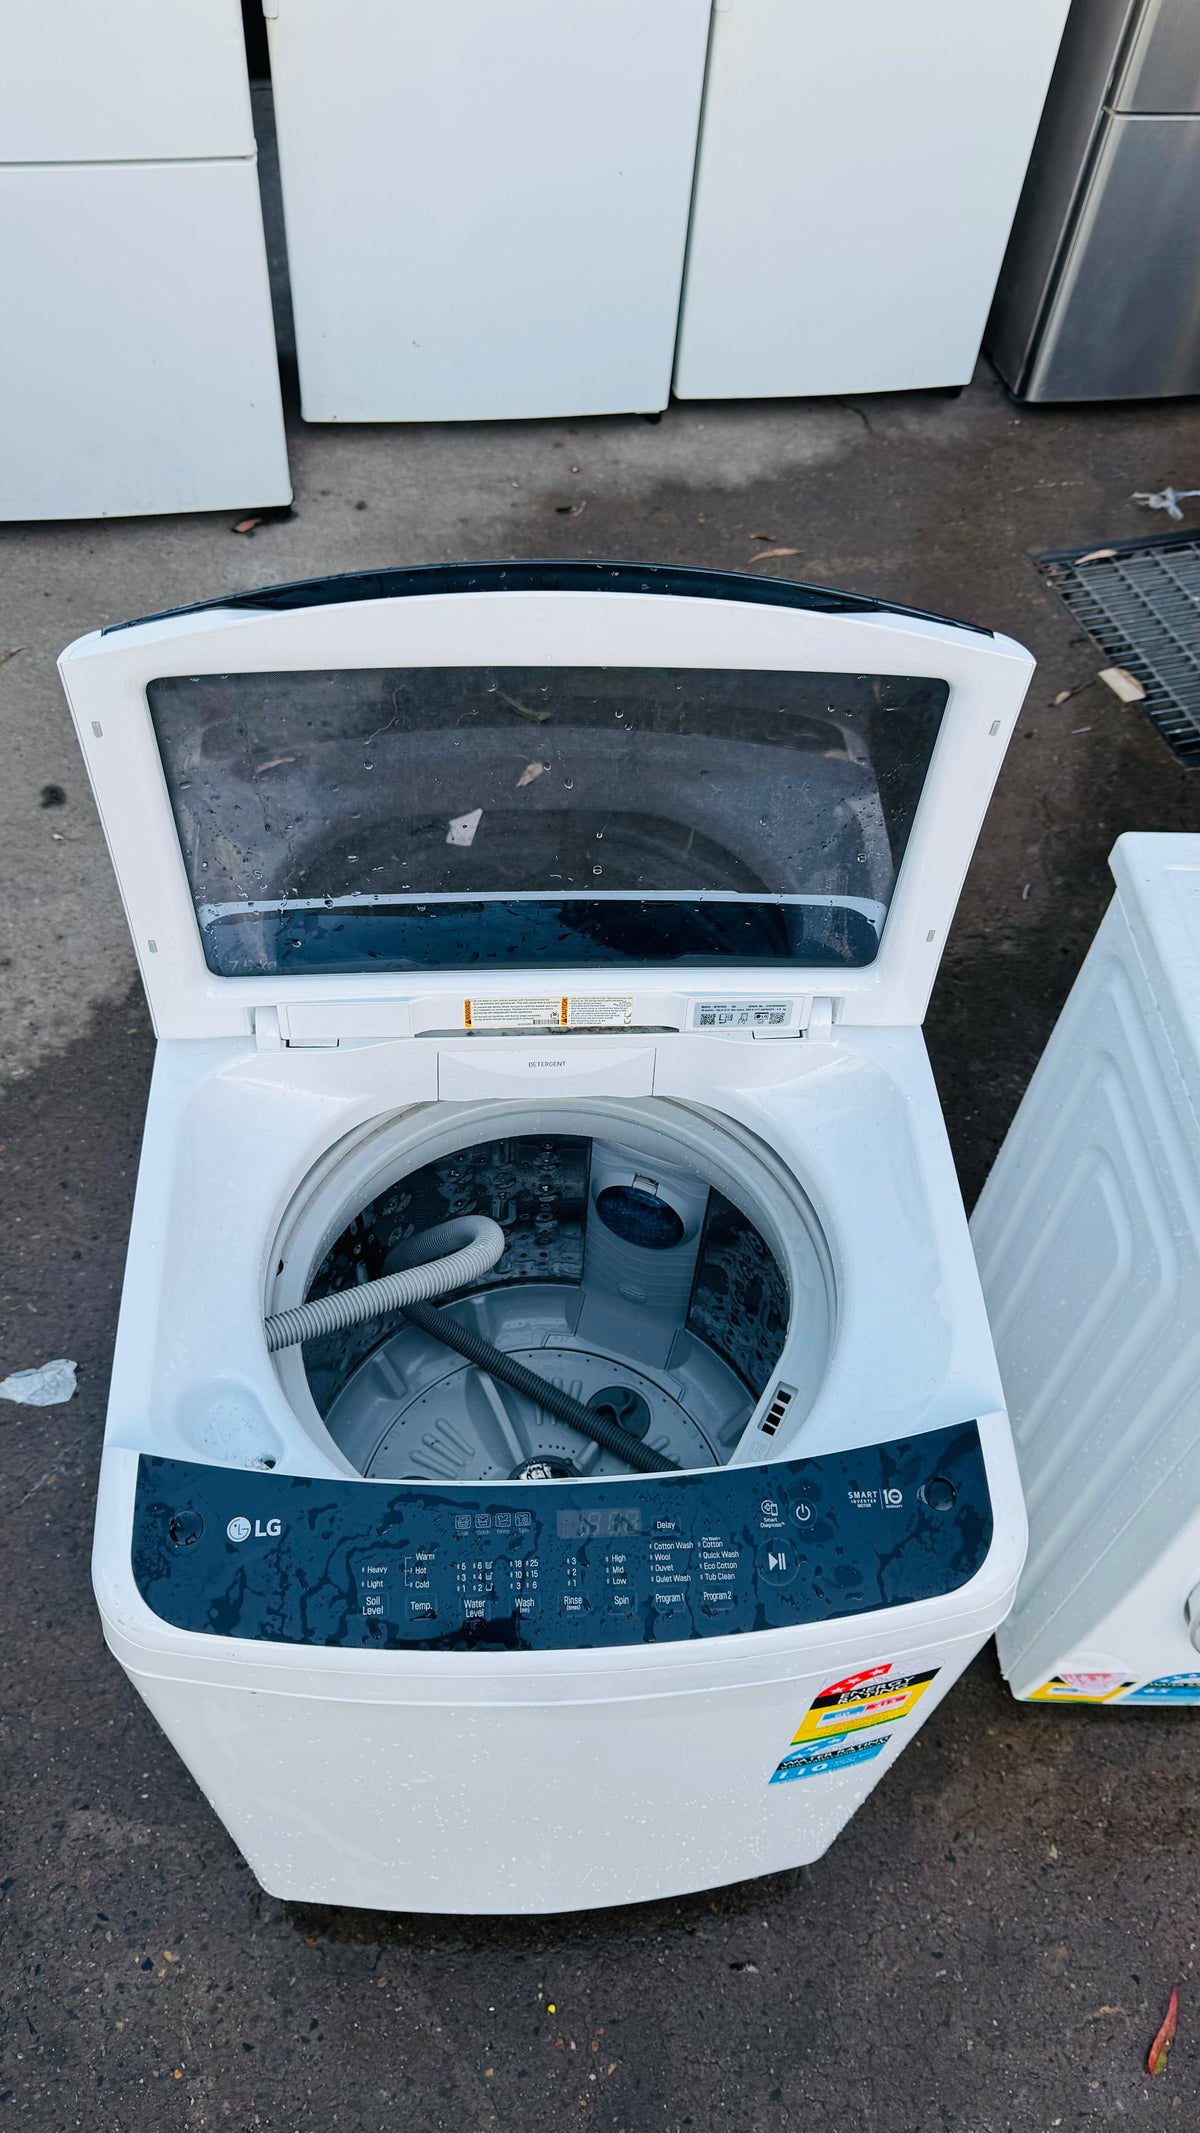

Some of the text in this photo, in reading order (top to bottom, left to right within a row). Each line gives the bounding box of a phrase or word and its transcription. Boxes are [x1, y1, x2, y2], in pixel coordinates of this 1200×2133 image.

[848, 1491, 877, 1499] SMART
[883, 1488, 903, 1504] 10
[254, 1518, 282, 1538] LG
[656, 1521, 676, 1530] Delay
[675, 1541, 694, 1549] Wash
[702, 1540, 723, 1548] Cotton
[415, 1552, 435, 1560] Warm
[611, 1554, 626, 1563] High
[654, 1553, 671, 1561] Wool
[721, 1550, 739, 1558] Wash
[514, 1559, 539, 1568] 18 25
[655, 1564, 674, 1572] Duvet
[367, 1566, 388, 1574] Heavy
[415, 1566, 427, 1574] Hot
[514, 1570, 538, 1579] 10 15
[612, 1566, 624, 1574] Mid
[612, 1577, 627, 1585] Low
[655, 1574, 692, 1583] Quiet Wash
[704, 1573, 717, 1581] Tub
[366, 1581, 384, 1589] Light
[415, 1580, 430, 1588] Cold
[366, 1596, 381, 1605] Soil
[463, 1599, 485, 1609] Water
[514, 1597, 535, 1607] Wash
[563, 1595, 583, 1605] Rinse
[614, 1595, 630, 1606] Spin
[362, 1605, 384, 1615] Level
[410, 1601, 433, 1611] Temp.
[465, 1608, 484, 1618] Level
[840, 1675, 916, 1696] ENERGY
